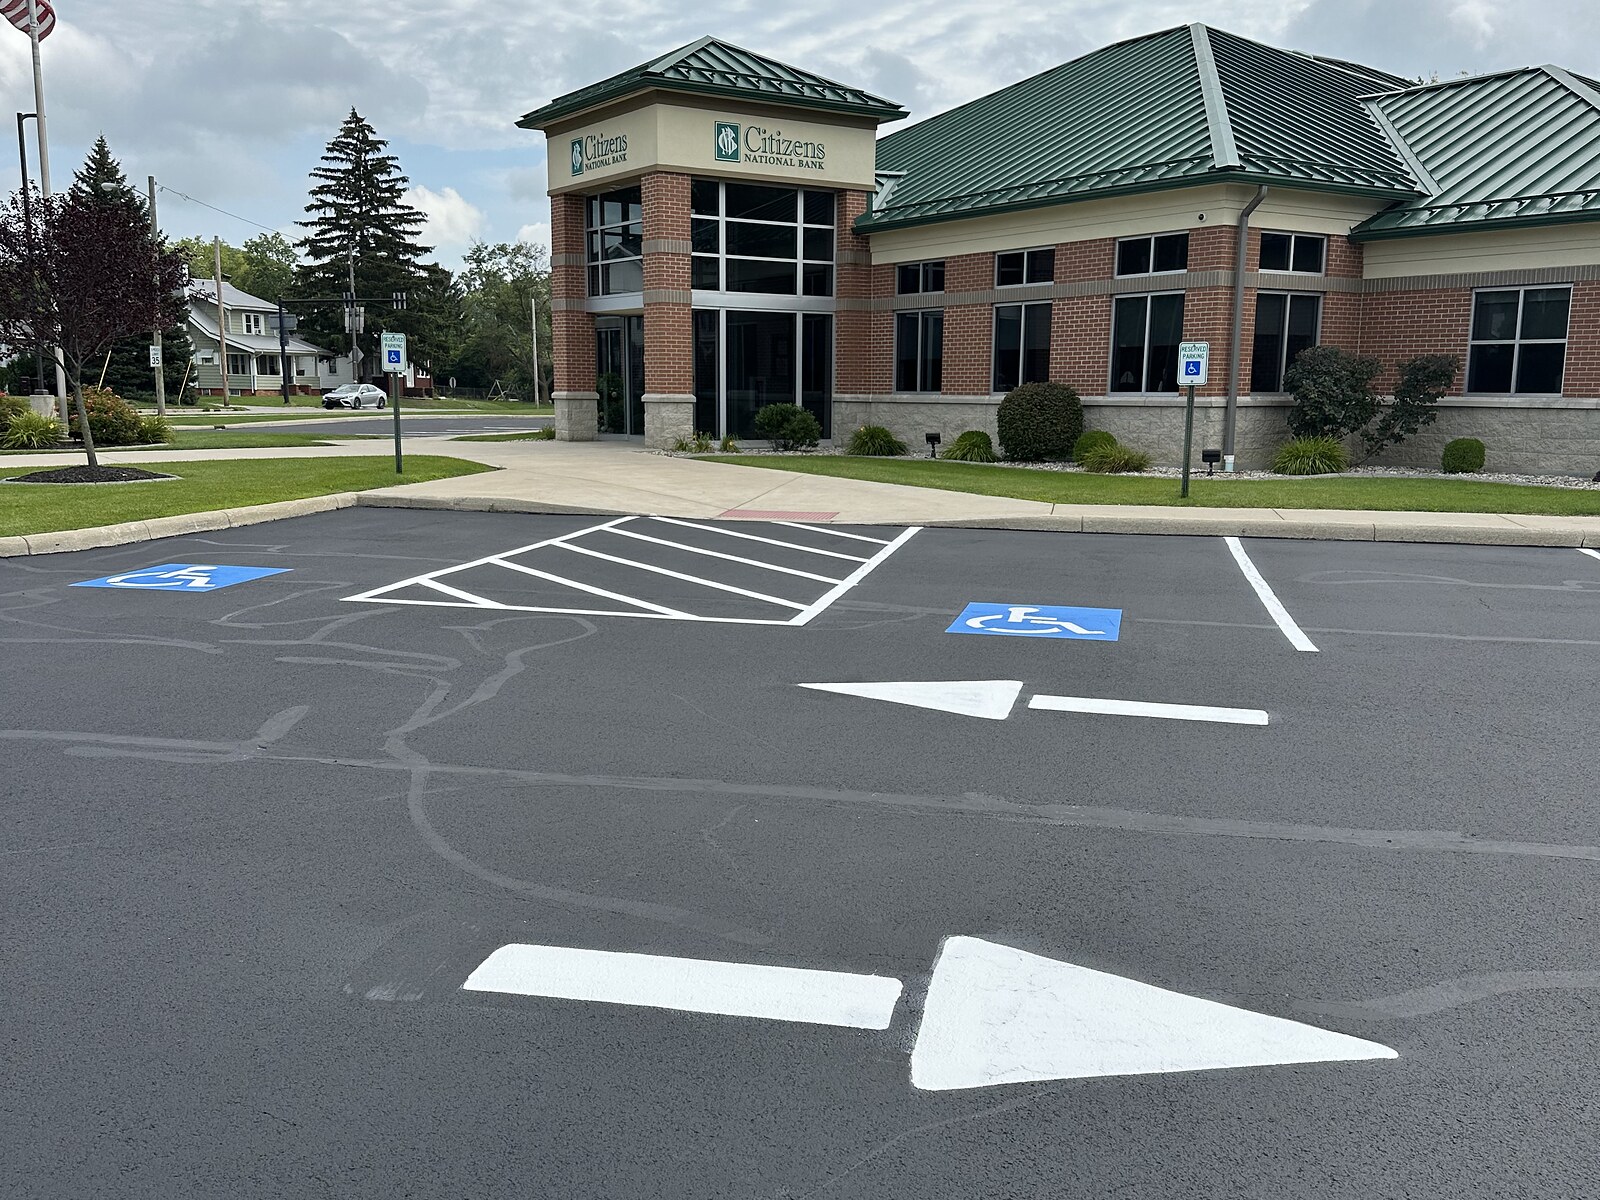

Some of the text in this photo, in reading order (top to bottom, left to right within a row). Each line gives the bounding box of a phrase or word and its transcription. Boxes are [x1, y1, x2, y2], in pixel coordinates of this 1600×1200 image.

[585, 133, 628, 161] Citizens
[744, 126, 826, 160] Citizens
[585, 153, 627, 171] NATIONAL BANK
[744, 153, 825, 170] NATIONAL BANK
[151, 356, 160, 365] 35
